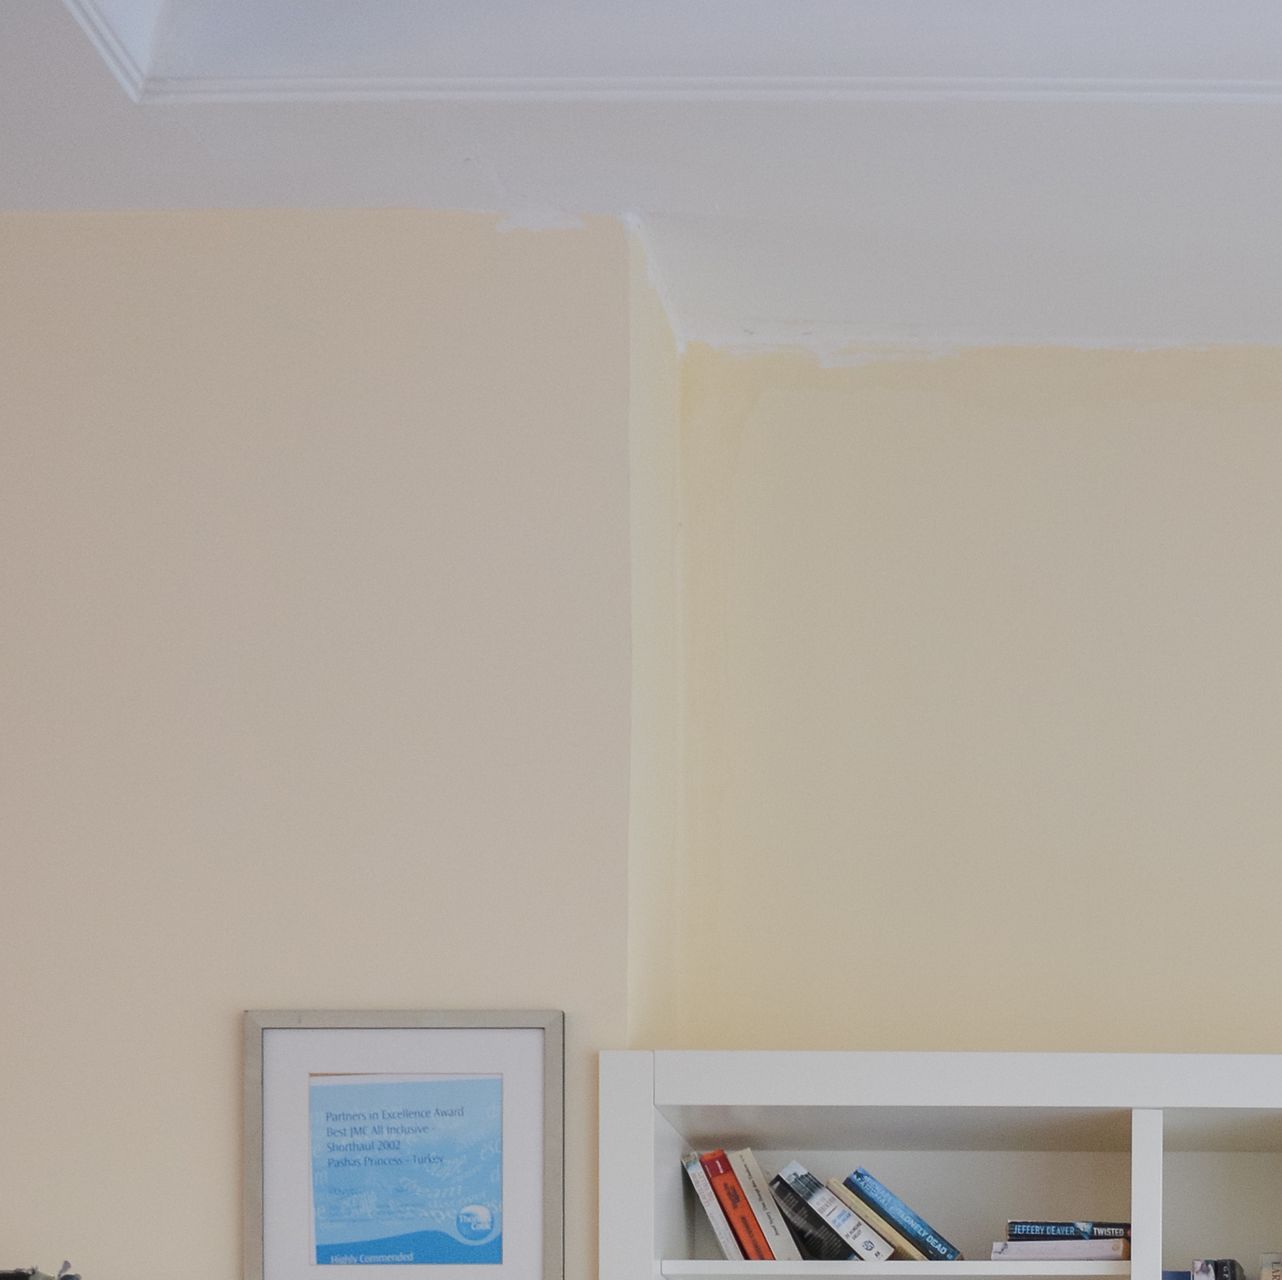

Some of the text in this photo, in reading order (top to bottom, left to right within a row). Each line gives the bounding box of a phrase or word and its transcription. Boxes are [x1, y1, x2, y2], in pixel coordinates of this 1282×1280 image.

[325, 1107, 464, 1122] Partners in Excellence Award
[326, 1127, 346, 1137] Best
[370, 1125, 384, 1136] All
[386, 1125, 429, 1135] Inclusive
[1013, 1223, 1045, 1235] JEFFERY
[1093, 1226, 1125, 1237] TWISTED
[926, 1232, 948, 1255] DEAD
[331, 1252, 414, 1264] Highly Commended
